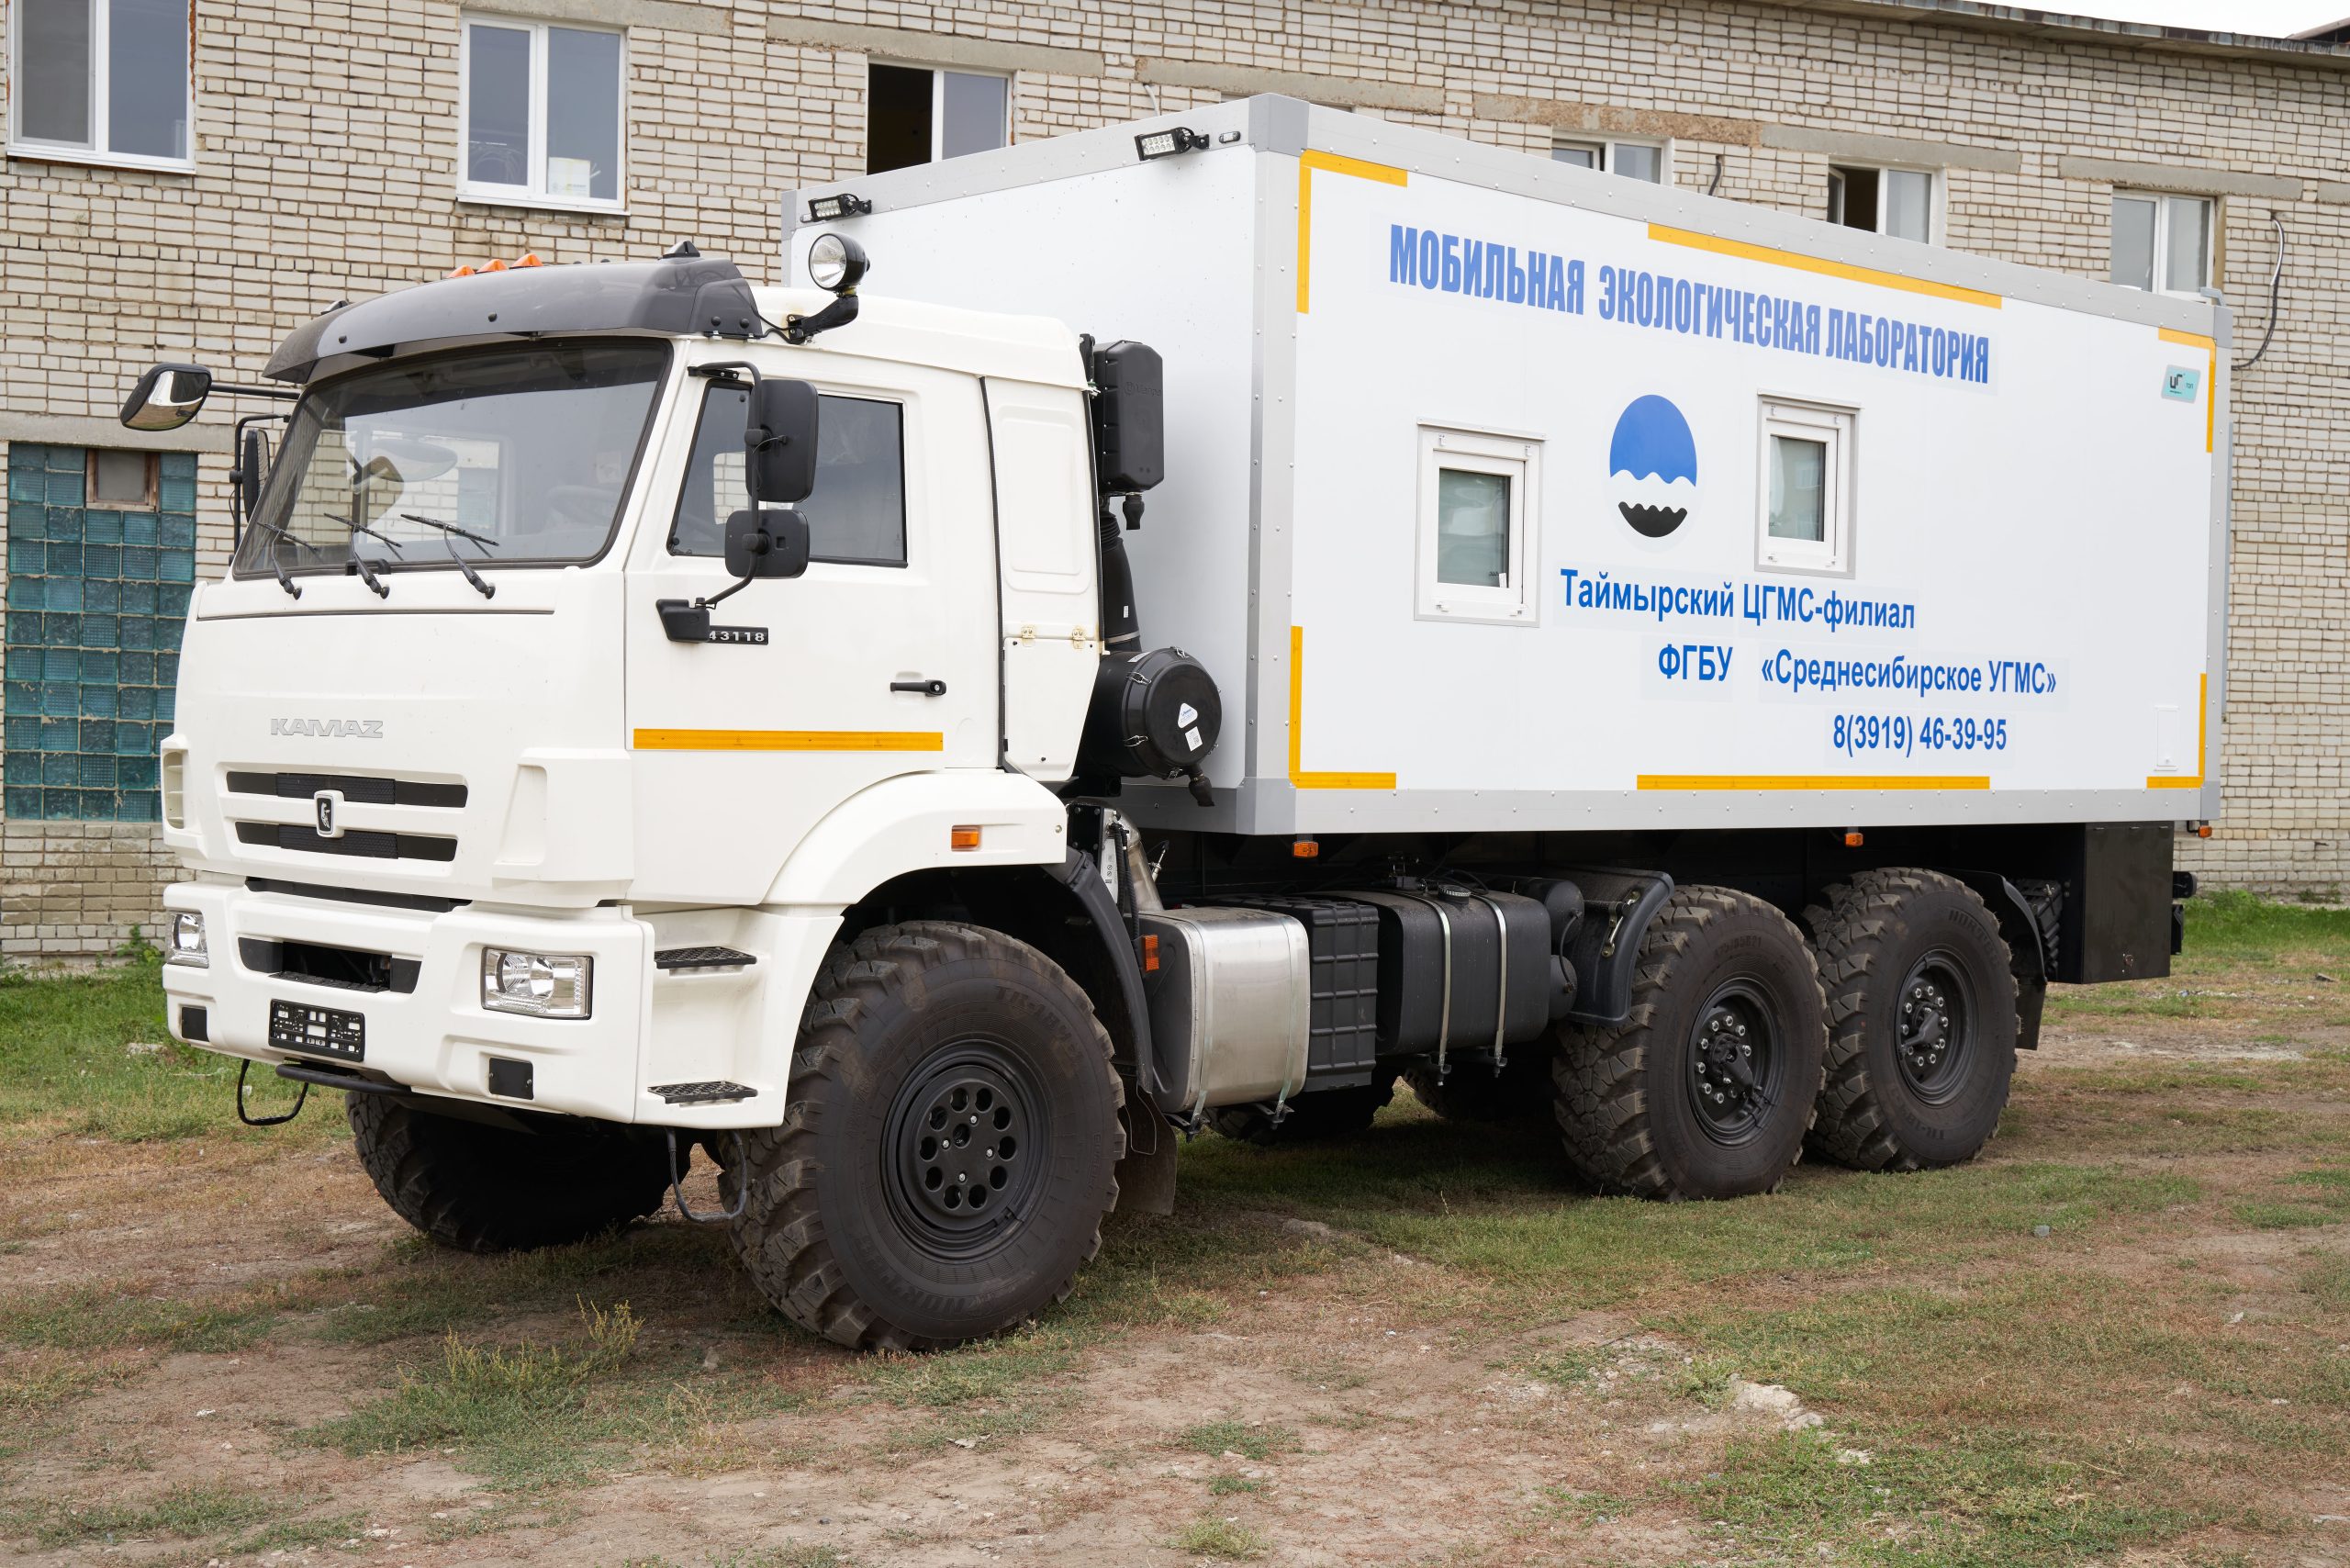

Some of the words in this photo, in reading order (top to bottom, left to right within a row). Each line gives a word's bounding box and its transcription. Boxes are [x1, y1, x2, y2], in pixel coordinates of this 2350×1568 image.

[1390, 224, 1584, 315] МОБИЛЬНАЯ
[1599, 265, 1820, 354] ЭКОЛОГИЧЕСКАЯ
[1825, 308, 1989, 384] ЛАБОРАТОРИЯ
[1560, 567, 1734, 622] Таймырский
[1743, 583, 1916, 633] ЦГМС-филиал
[709, 631, 765, 642] 43118
[1658, 643, 1733, 683] ФГБУ
[1762, 648, 1982, 699] «Среднесибирское
[1988, 660, 2057, 695] УГМС»
[270, 718, 384, 739] KAMAZ
[1832, 714, 1913, 757] 8(3919)
[1919, 717, 2008, 750] 46-39-95
